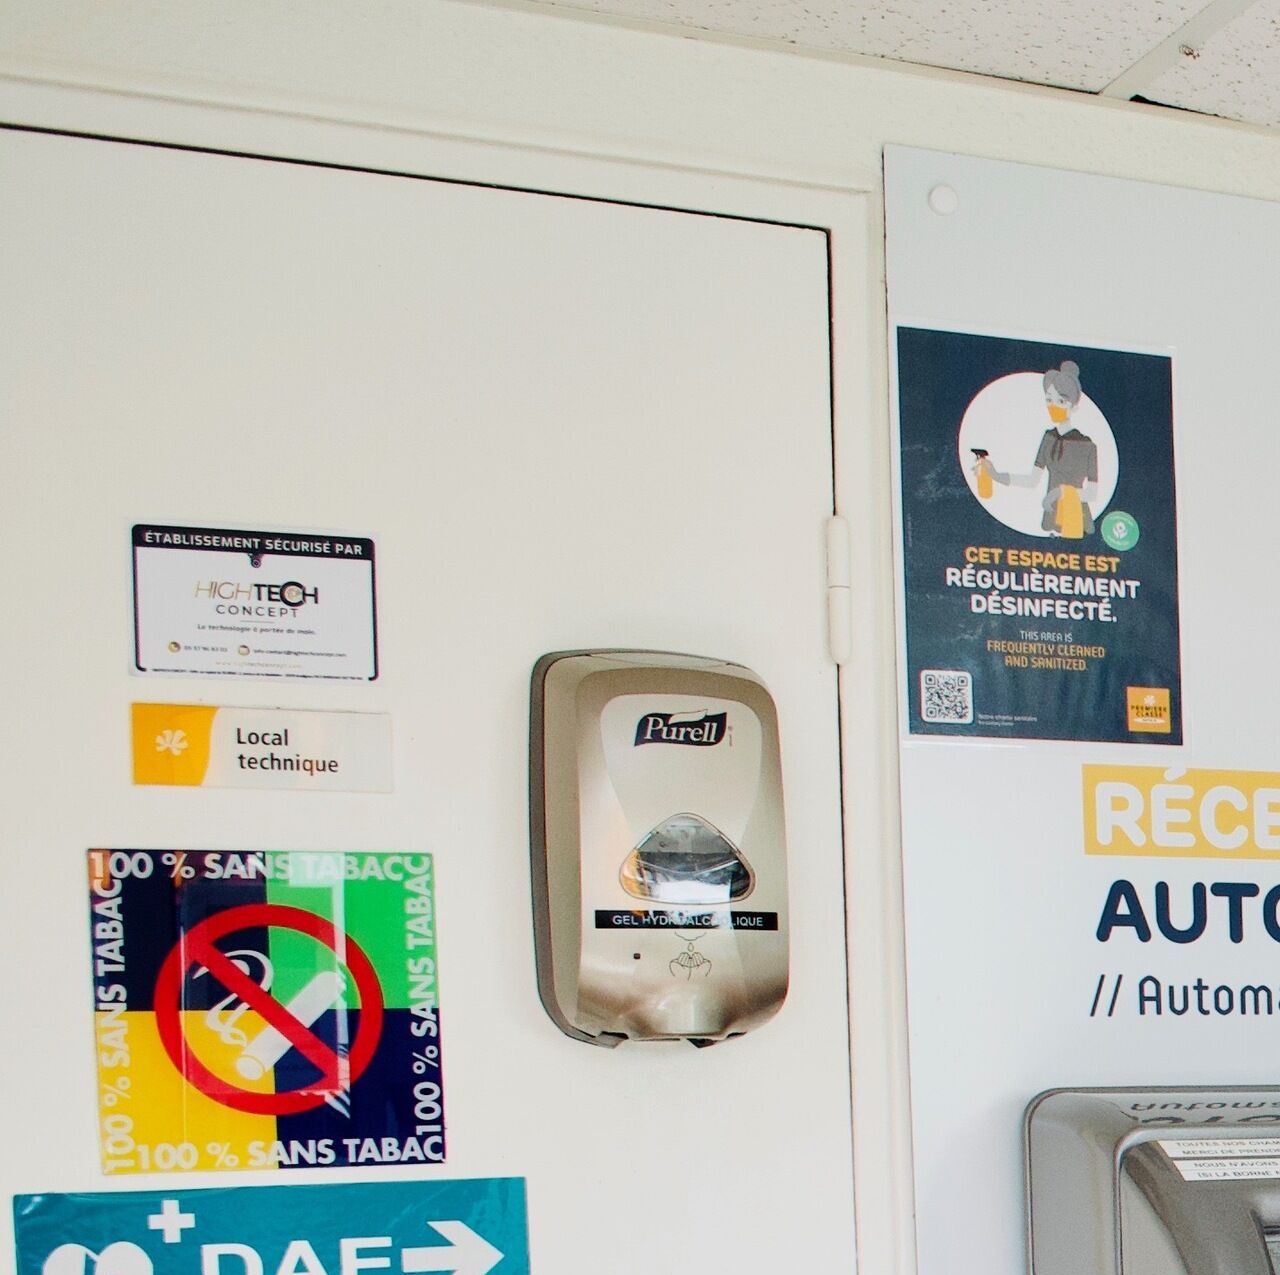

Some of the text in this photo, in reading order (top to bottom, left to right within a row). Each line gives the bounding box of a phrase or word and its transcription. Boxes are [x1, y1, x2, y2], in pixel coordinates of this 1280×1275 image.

[144, 530, 363, 556] ÉTABLISSEMENT SÉCURISÉ PAR
[965, 546, 1120, 572] CET ESPACE EST
[194, 580, 319, 607] HIGHTECH
[946, 562, 1140, 599] RÉGULIÈREMENT
[215, 603, 299, 618] CONCEPT
[971, 590, 1117, 622] DÉSINFECTÉ.
[987, 640, 1105, 658] FREQUENTLY CLEANED
[1020, 631, 1072, 642] THIS AREA IS
[1005, 656, 1028, 668] AND
[236, 728, 289, 746] Local
[644, 715, 718, 745] Purell
[238, 753, 339, 776] technique
[91, 851, 405, 881] 100 % SANS TABAC
[613, 915, 639, 926] GEL
[137, 1136, 444, 1170] 100 % SANS TABAC
